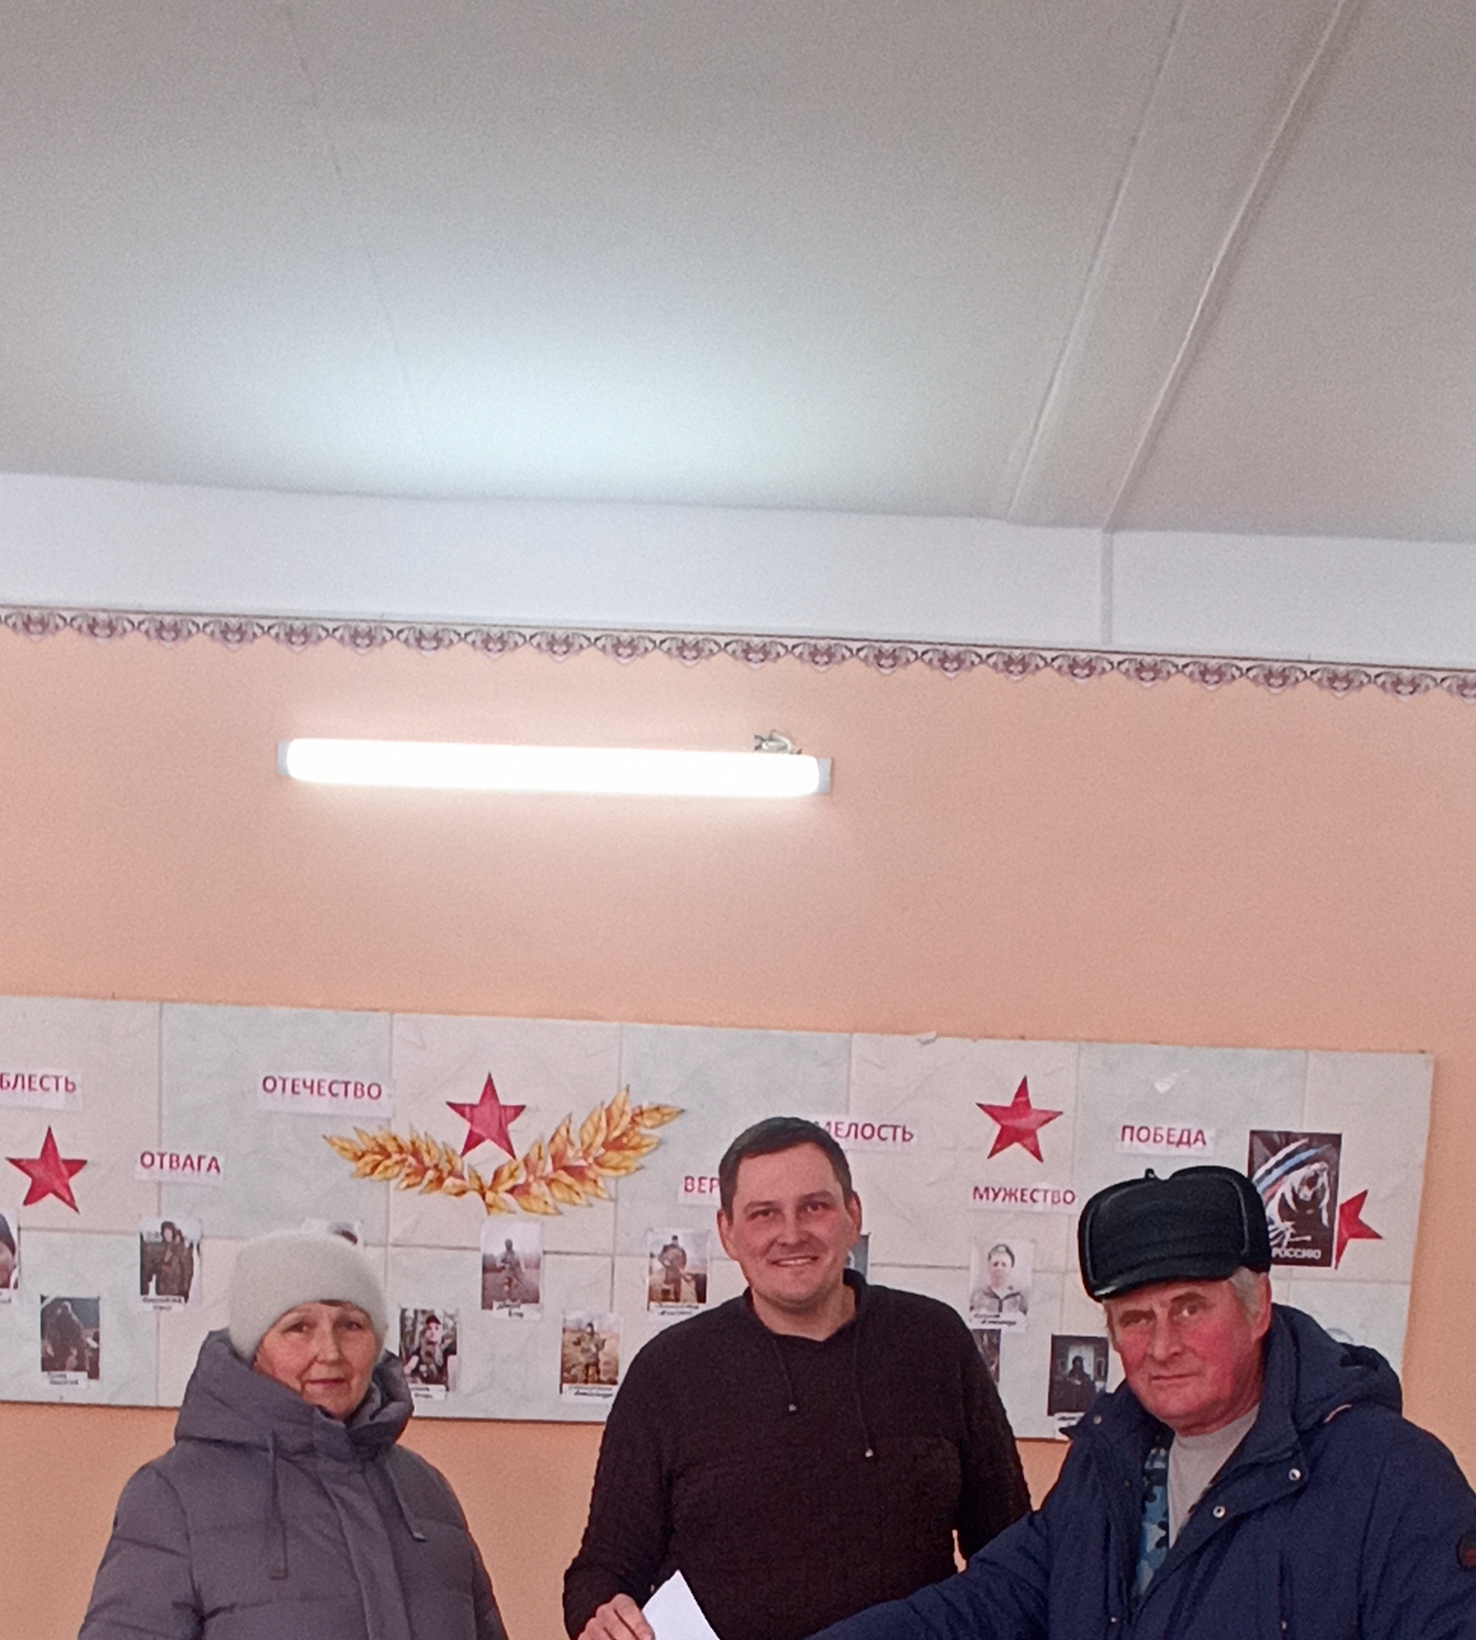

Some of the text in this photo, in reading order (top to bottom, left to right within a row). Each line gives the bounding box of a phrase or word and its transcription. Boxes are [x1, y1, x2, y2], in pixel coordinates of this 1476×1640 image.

[0, 1072, 77, 1094] БЛЕСТЬ
[261, 1075, 383, 1100] ОТЕЧЕСТВО
[1120, 1125, 1208, 1147] ПОБЕДА
[139, 1151, 221, 1174] ОТВАГА
[972, 1185, 1076, 1206] МУЖЕСТВО
